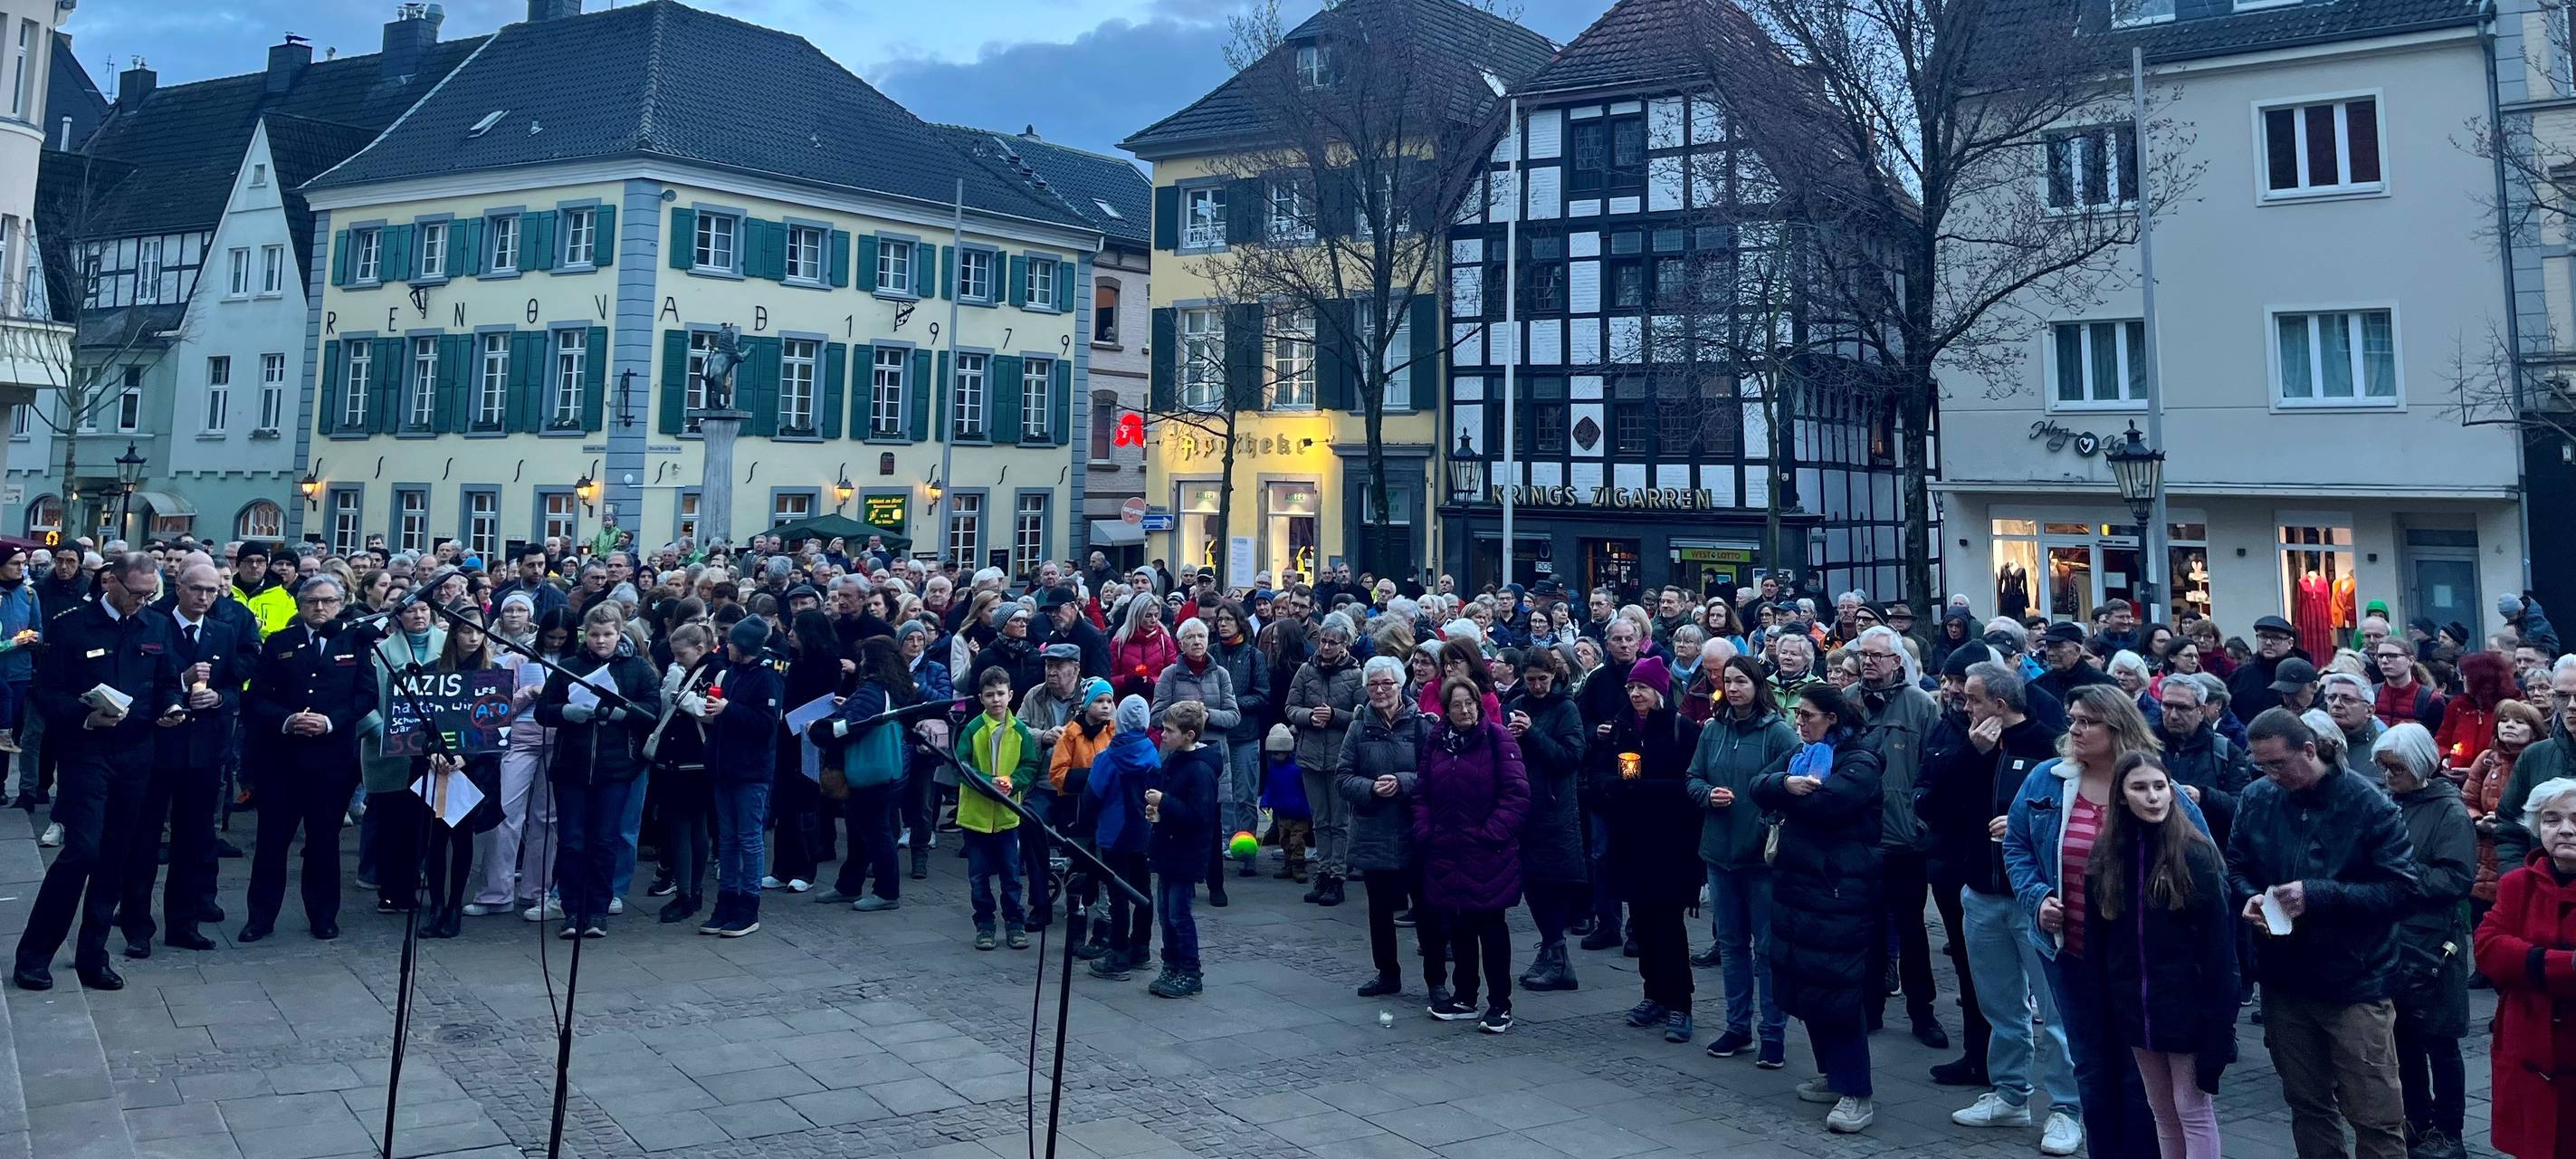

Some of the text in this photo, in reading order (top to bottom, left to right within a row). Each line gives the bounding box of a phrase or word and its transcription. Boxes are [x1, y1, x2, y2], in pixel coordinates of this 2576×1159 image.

[1196, 492, 1214, 500] ADLER
[1284, 492, 1304, 501] ADLER
[1492, 484, 1713, 511] KRINGS ZIGARREN
[1691, 550, 1741, 560] WEST LOTTO
[393, 674, 463, 696] NAZIS
[391, 698, 473, 715] haten wir
[389, 725, 411, 734] war
